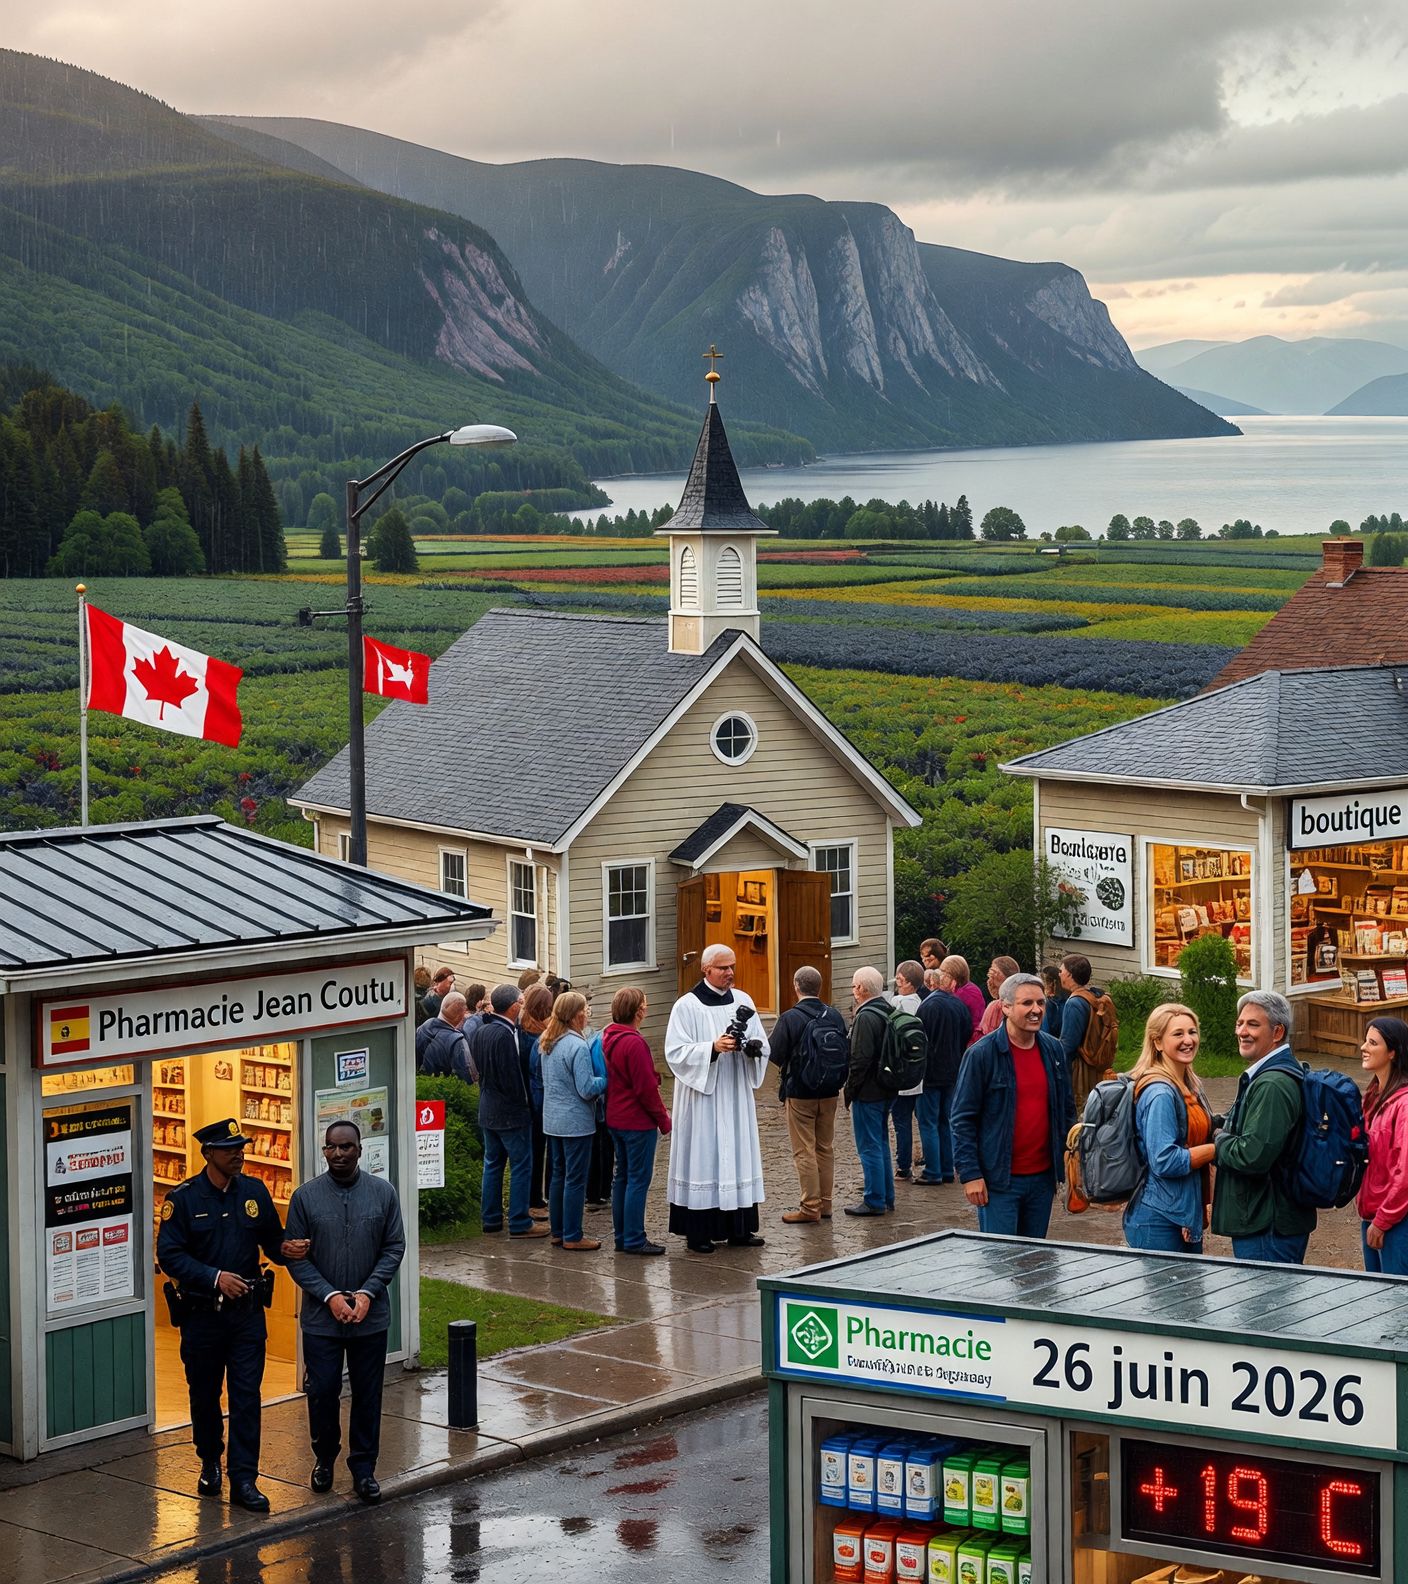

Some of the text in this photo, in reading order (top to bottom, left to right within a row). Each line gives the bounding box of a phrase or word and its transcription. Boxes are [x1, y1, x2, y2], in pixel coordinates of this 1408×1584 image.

[1301, 800, 1401, 837] boutique
[99, 994, 244, 1041] Pharmacie
[252, 990, 312, 1021] Jean
[847, 1315, 993, 1361] Pharmacie
[1033, 1338, 1093, 1392] 26
[1107, 1345, 1209, 1410] juin
[1231, 1361, 1364, 1426] 2026
[1321, 1479, 1363, 1555] C
